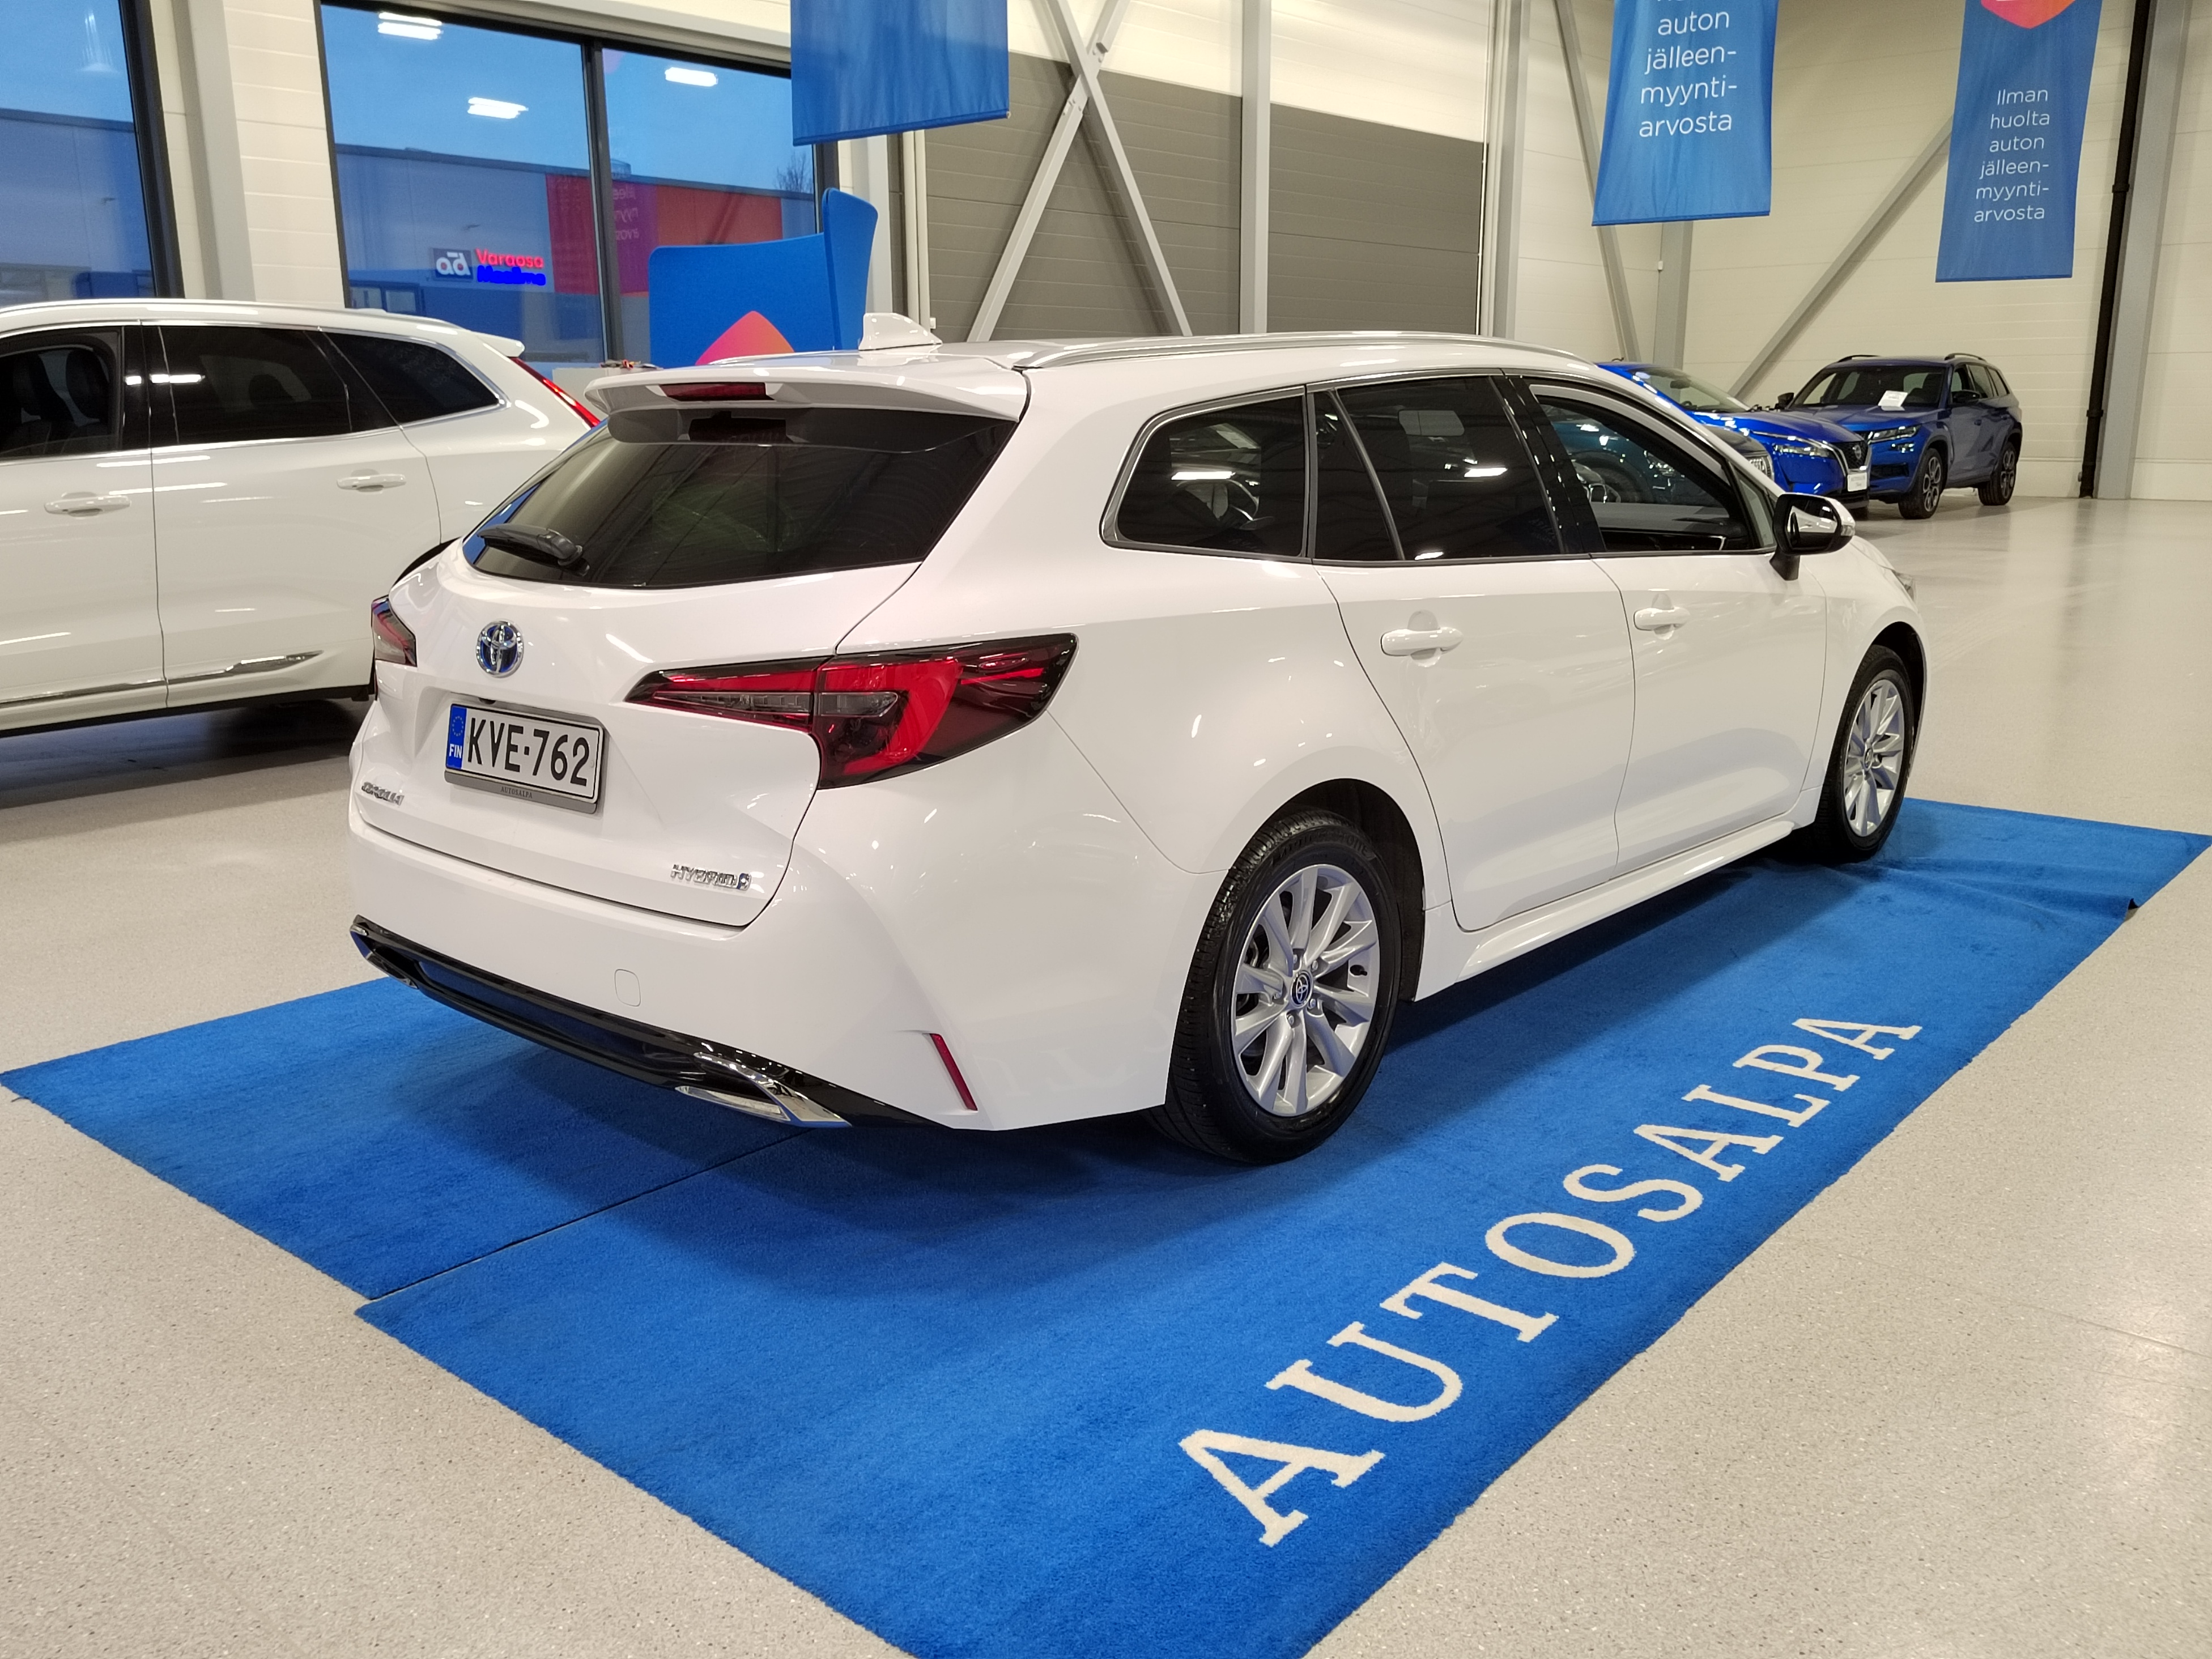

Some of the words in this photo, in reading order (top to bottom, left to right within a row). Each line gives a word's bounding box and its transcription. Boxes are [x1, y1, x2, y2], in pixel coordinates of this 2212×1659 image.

[1658, 11, 1730, 35] auton
[1644, 45, 1737, 75] jälleen-
[1640, 74, 1738, 107] myynti-
[1997, 88, 2048, 105] Ilman
[1639, 110, 1732, 137] arvosta
[1990, 109, 2051, 129] huolta
[1989, 135, 2044, 152] auton
[1979, 159, 2049, 180] jälleen-
[1975, 181, 2049, 201] myynti-
[1973, 206, 2045, 222] arvosta
[476, 248, 545, 269] Varaosa
[449, 743, 463, 759] FIN
[467, 717, 590, 786] KVE-762
[500, 786, 533, 799] AUTOSALPA
[1177, 1018, 1923, 1548] AUTOSALPA
